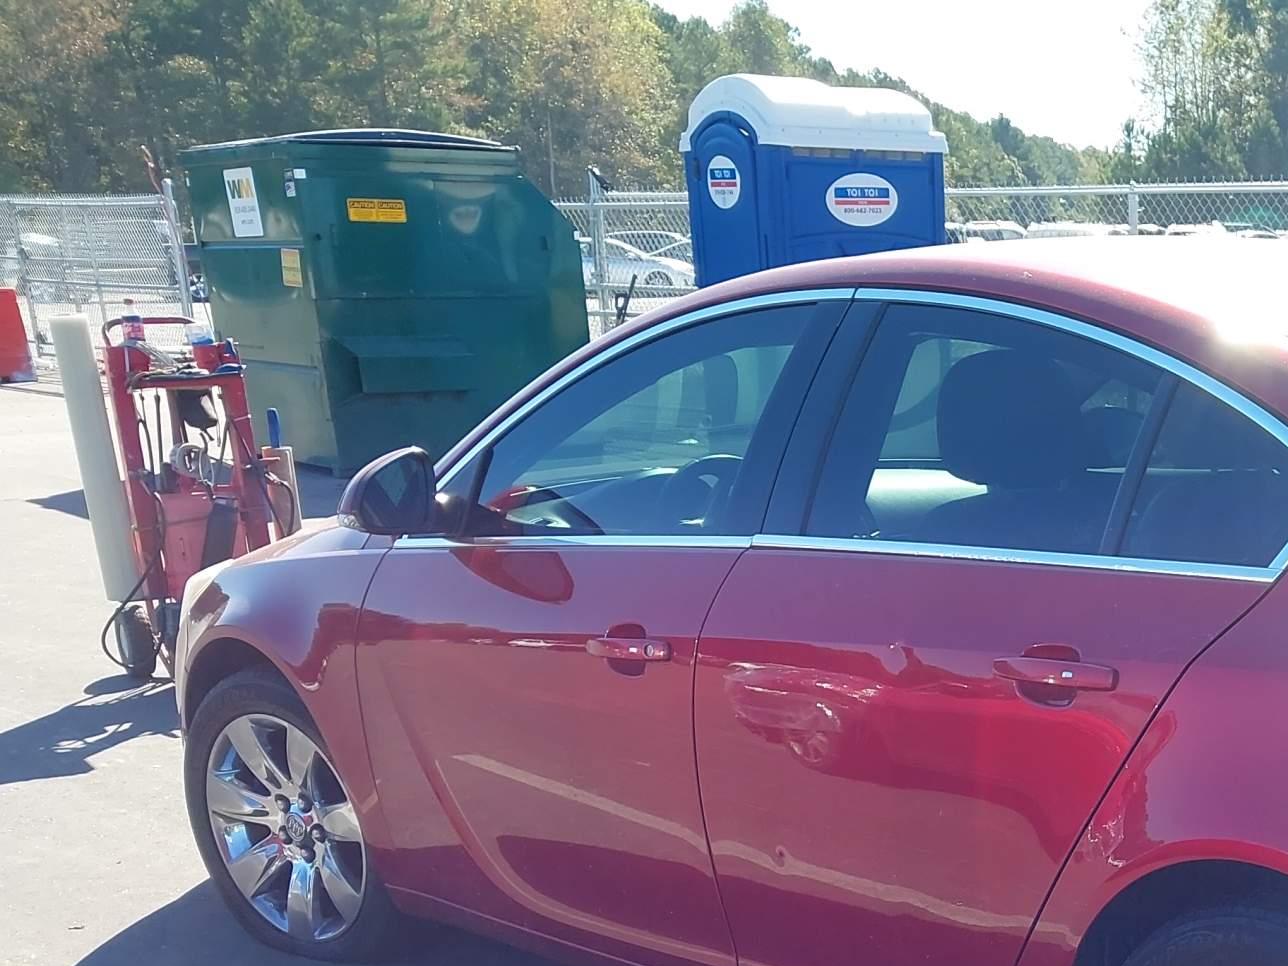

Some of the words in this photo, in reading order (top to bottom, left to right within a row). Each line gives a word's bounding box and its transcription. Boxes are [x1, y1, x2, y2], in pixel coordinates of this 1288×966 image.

[226, 178, 255, 199] WM
[847, 188, 861, 197] TOI
[864, 188, 878, 197] TOI
